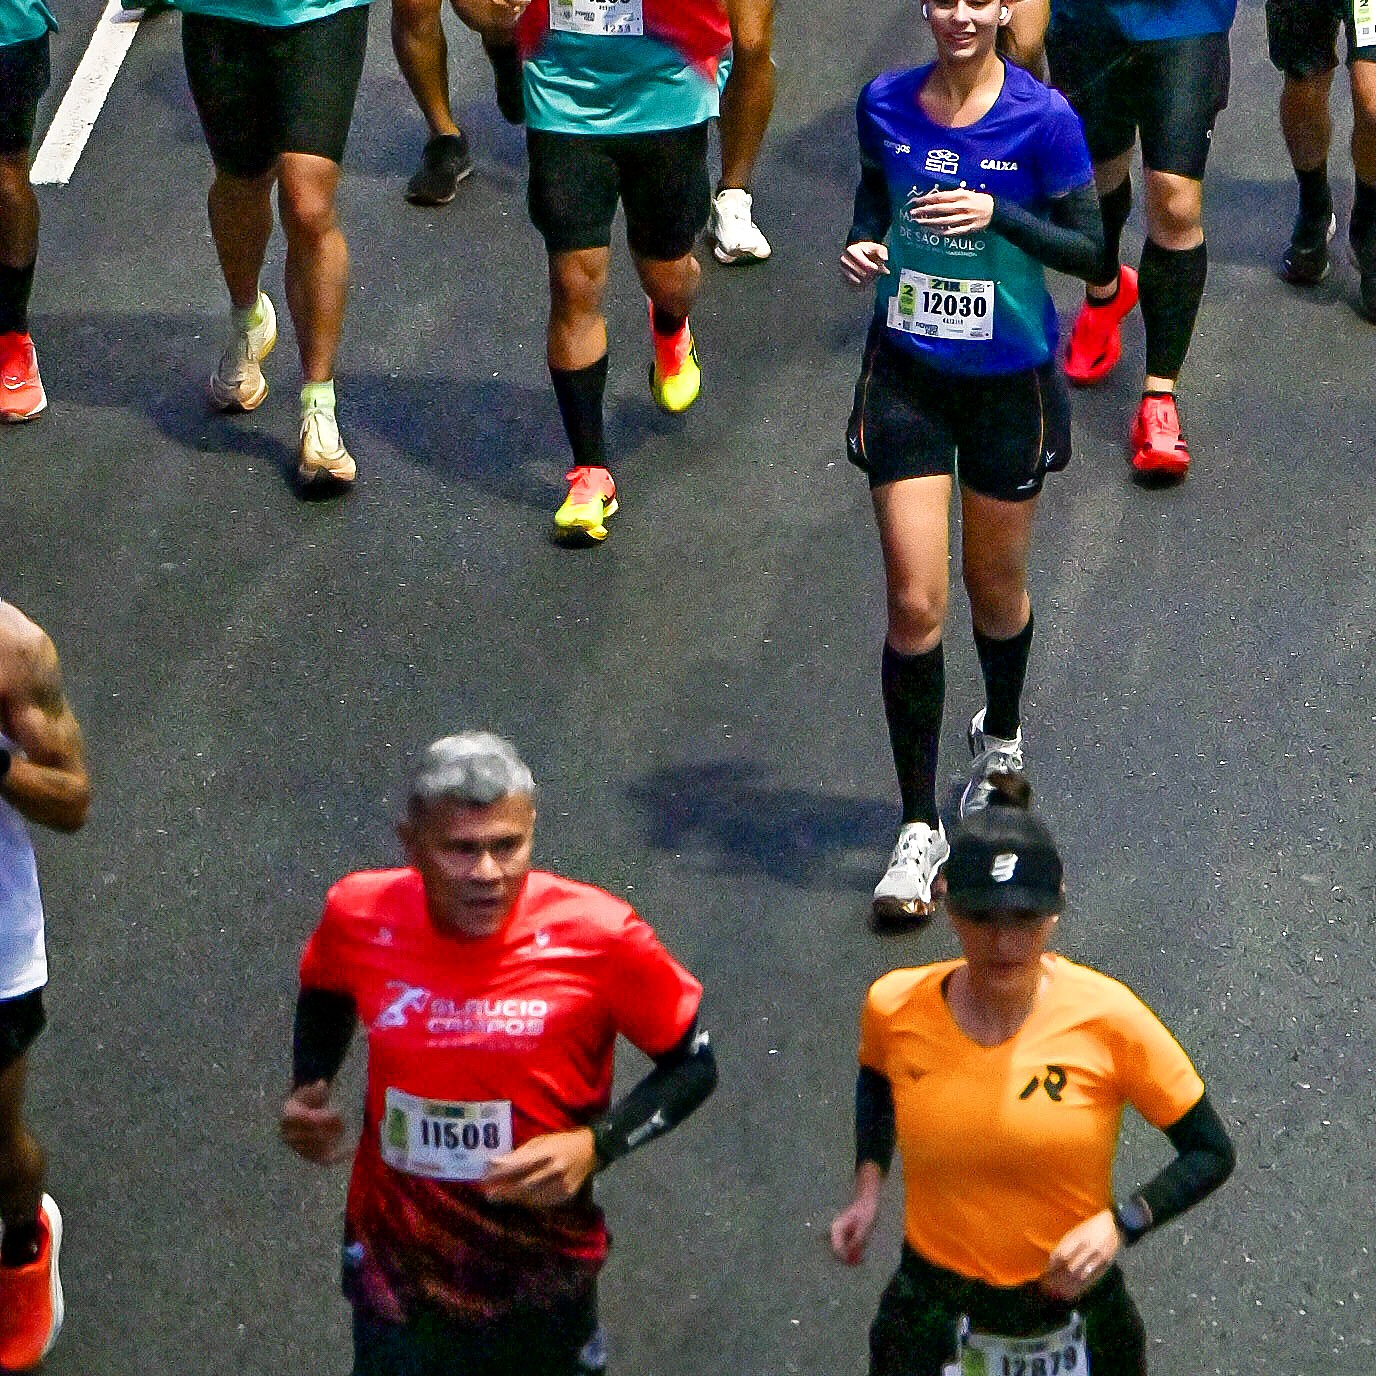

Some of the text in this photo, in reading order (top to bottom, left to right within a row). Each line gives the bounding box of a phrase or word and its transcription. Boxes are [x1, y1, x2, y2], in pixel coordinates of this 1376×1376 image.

[980, 158, 1018, 171] CAIXA
[944, 237, 986, 252] PAULO
[922, 291, 988, 318] 12030
